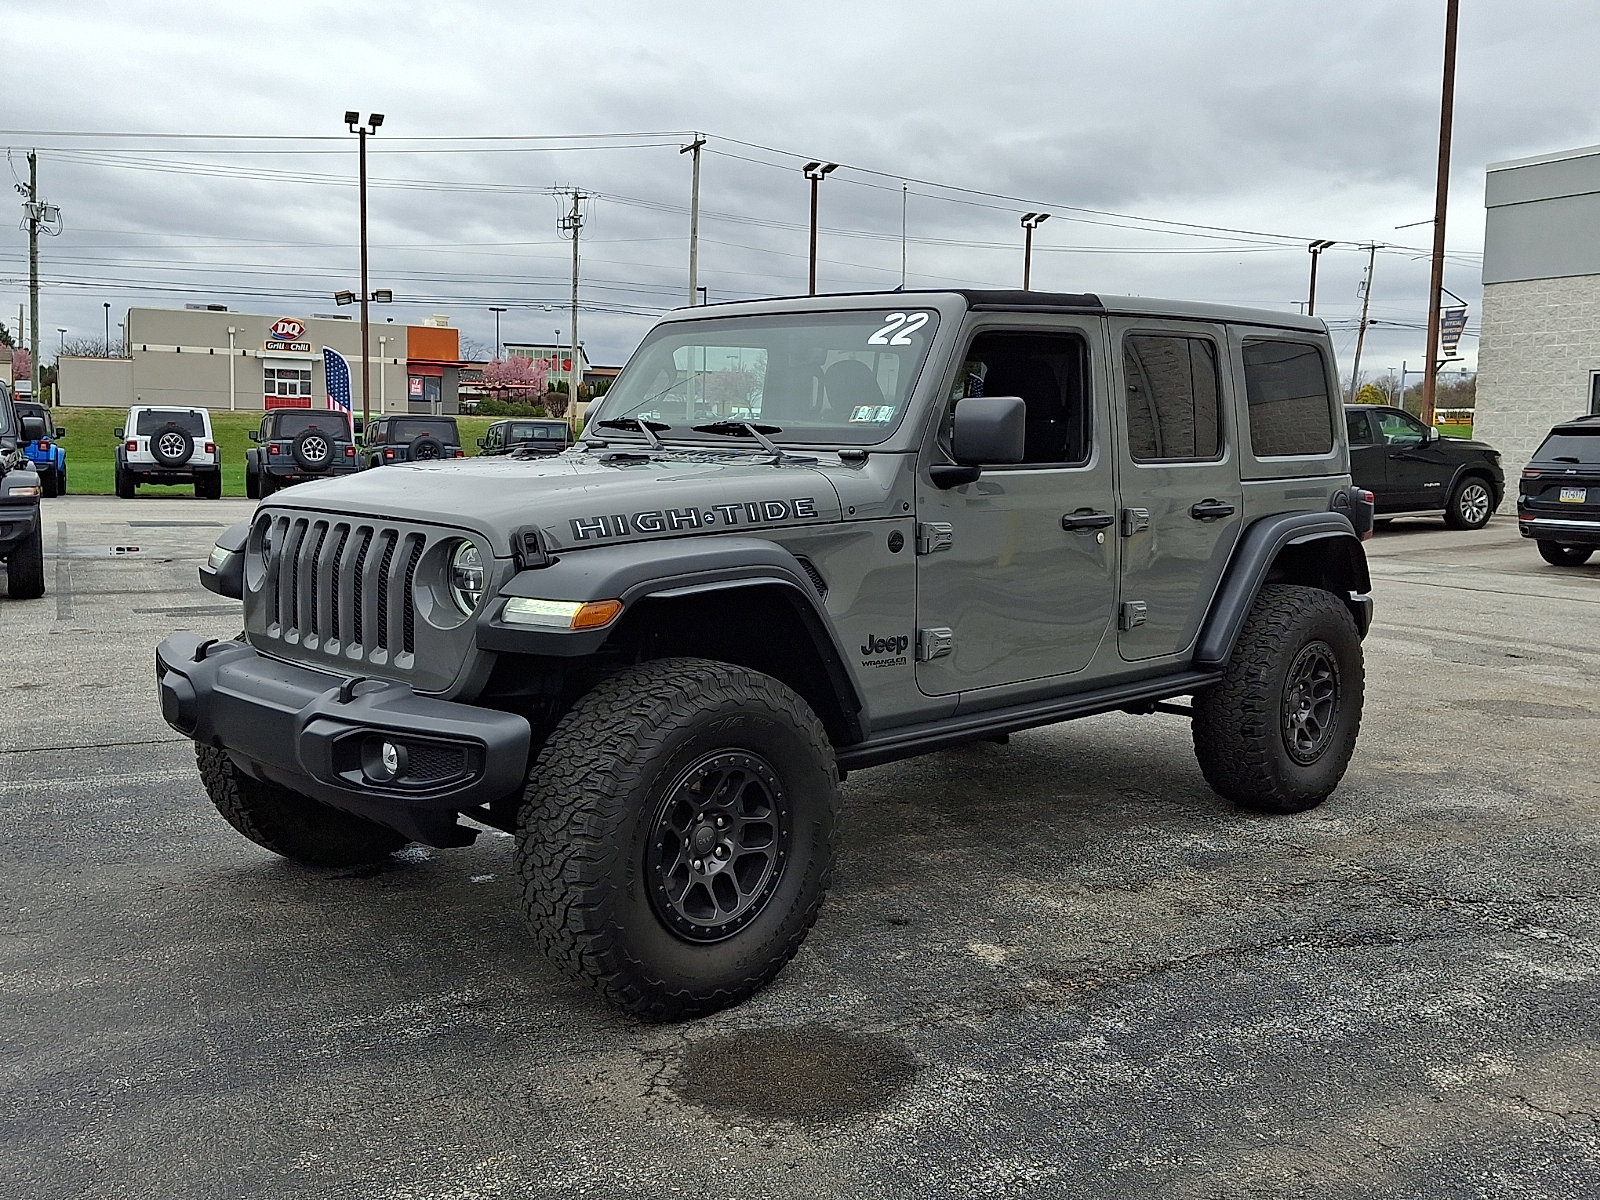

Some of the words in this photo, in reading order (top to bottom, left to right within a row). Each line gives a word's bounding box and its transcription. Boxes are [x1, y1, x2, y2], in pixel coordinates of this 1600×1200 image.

[276, 322, 300, 336] DQ
[867, 312, 929, 346] 22
[267, 342, 285, 350] Grill
[290, 343, 309, 351] Chill
[569, 507, 702, 540] HIGH
[711, 498, 818, 525] TIDE
[860, 634, 908, 656] Jeep
[861, 656, 907, 667] WRANGLER
